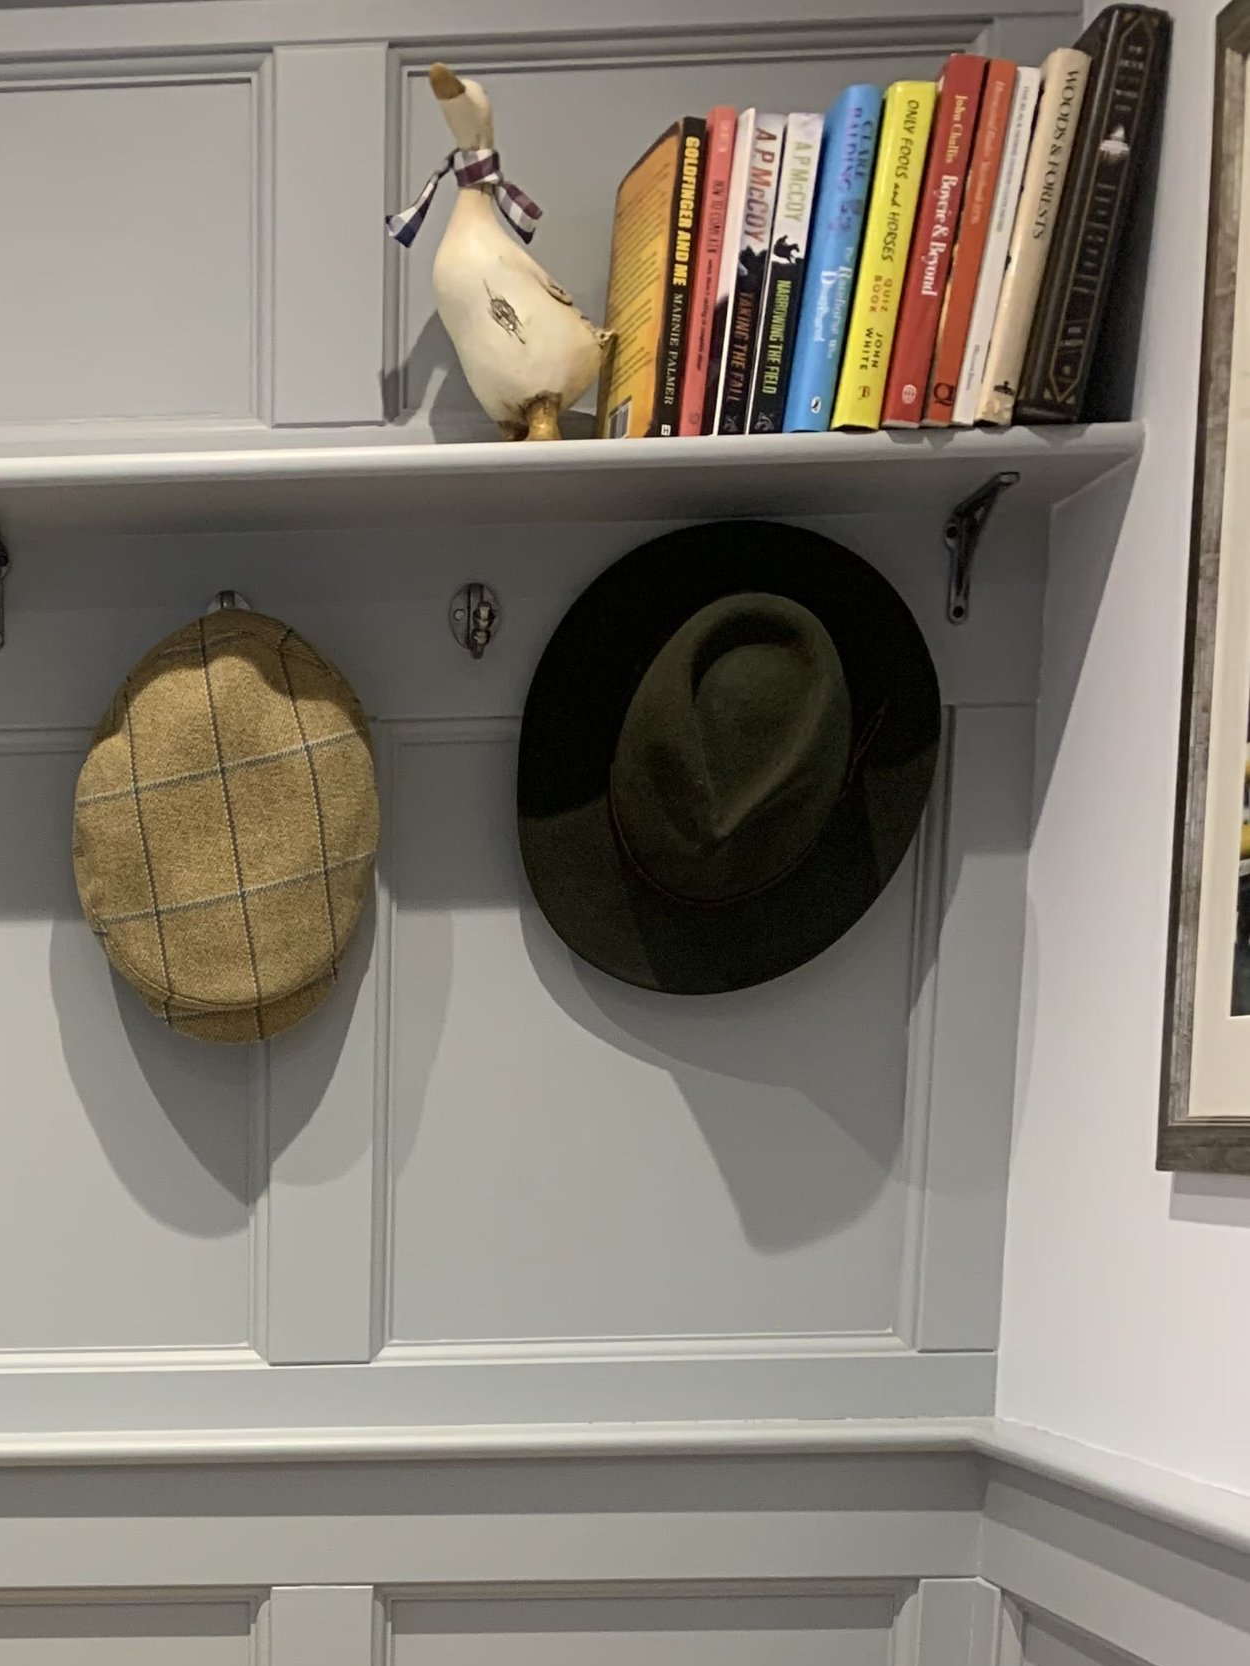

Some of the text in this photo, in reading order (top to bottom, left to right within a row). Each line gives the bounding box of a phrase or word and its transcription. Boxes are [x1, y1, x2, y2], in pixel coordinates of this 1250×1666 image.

[953, 95, 968, 121] John
[855, 120, 874, 181] CLARE
[946, 123, 963, 164] Challis
[1033, 70, 1080, 239] WOODS & FORESTS
[743, 165, 774, 244] McCOY
[784, 167, 810, 222] McCOY
[881, 99, 920, 263] ONLY FOOLS and HORSES
[931, 224, 949, 237] &
[664, 135, 700, 406] GOLDFINGER AND ME MARNIE PALMER
[869, 274, 883, 313] BOOK
[880, 278, 893, 313] QUIZ
[921, 240, 947, 297] Beyond
[727, 291, 754, 403] TAKING THE FALL
[762, 279, 792, 396] NARROWING THE FIELD
[859, 327, 875, 371] WHITE
[871, 332, 884, 369] JOHN
